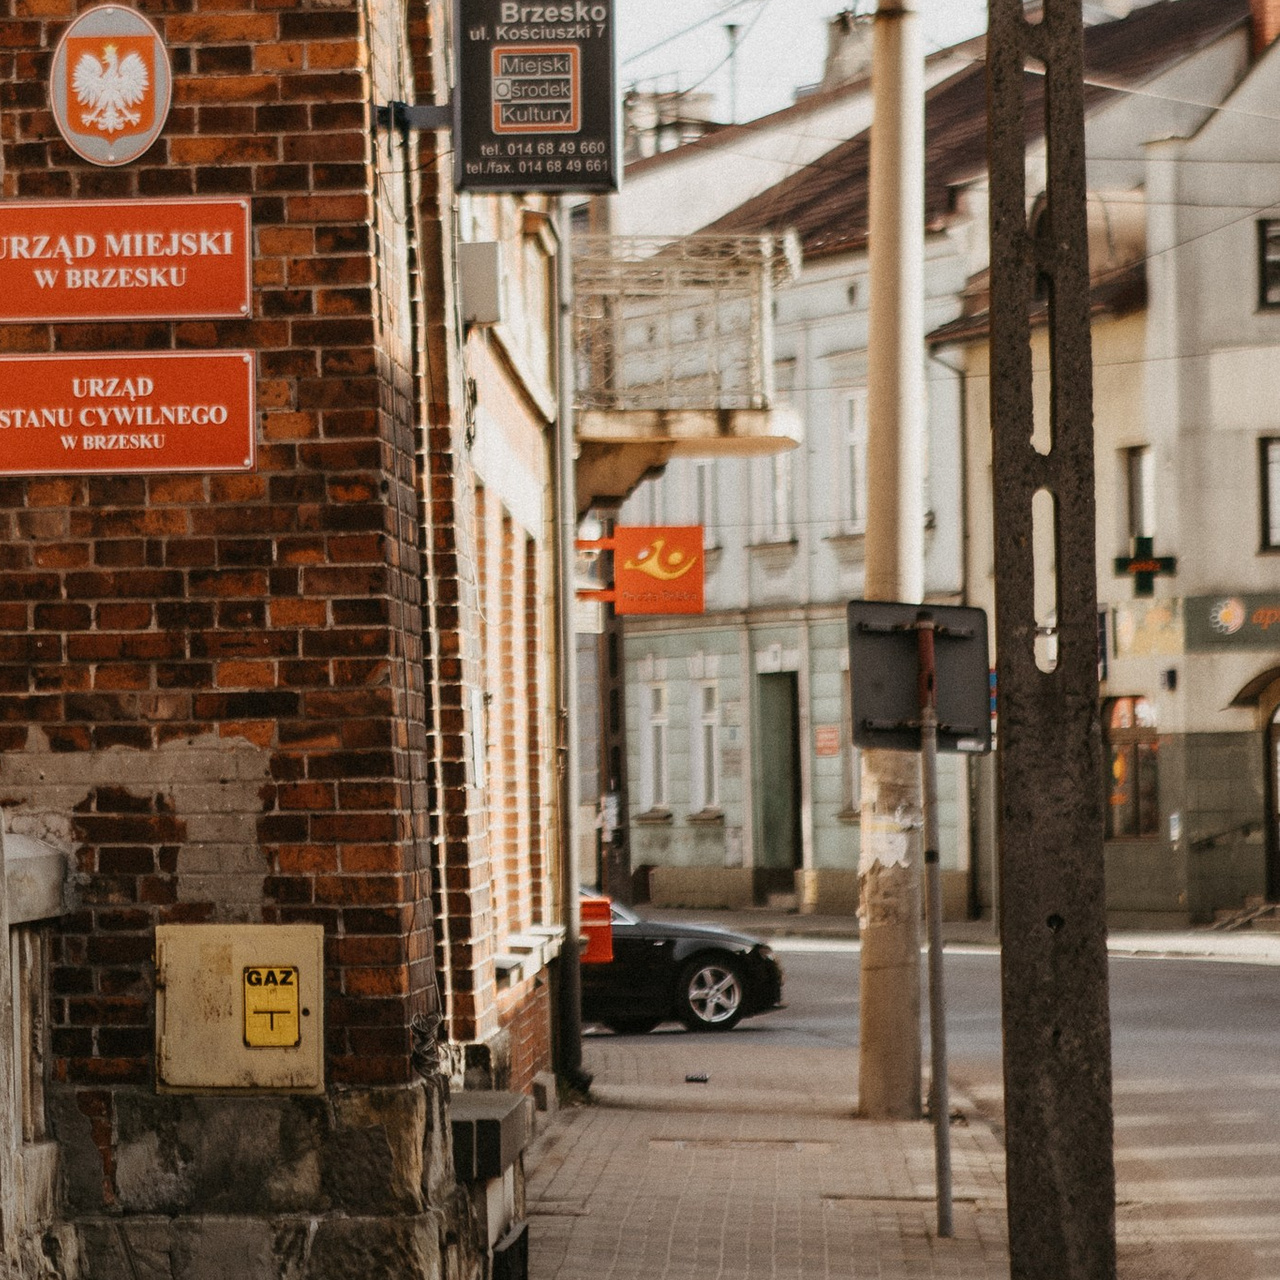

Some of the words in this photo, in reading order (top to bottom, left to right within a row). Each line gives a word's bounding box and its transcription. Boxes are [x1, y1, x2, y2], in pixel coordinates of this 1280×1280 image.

[501, 1, 607, 23] Brzesko
[470, 27, 490, 41] ul.
[496, 25, 591, 40] Kościuszki
[596, 25, 606, 39] 7
[502, 57, 570, 76] Miejski
[496, 82, 570, 98] Ośrodek
[502, 106, 570, 124] Kultury
[481, 143, 503, 156] tel.
[507, 143, 533, 155] 014
[537, 142, 554, 155] 68
[559, 141, 576, 154] 49
[580, 141, 606, 154] 660
[466, 161, 515, 174] tel./fax.
[519, 161, 543, 173] 014
[546, 160, 562, 173] 68
[566, 160, 581, 173] 49
[585, 159, 608, 172] 661
[104, 231, 234, 258] MIEJSKI
[34, 269, 60, 289] W
[66, 267, 188, 289] BRZESKU
[72, 376, 154, 402] URZĄD
[79, 405, 228, 427] CYWILNEGO
[60, 435, 79, 450] W
[82, 434, 166, 450] BRZESKU
[246, 970, 294, 987] GAZ
